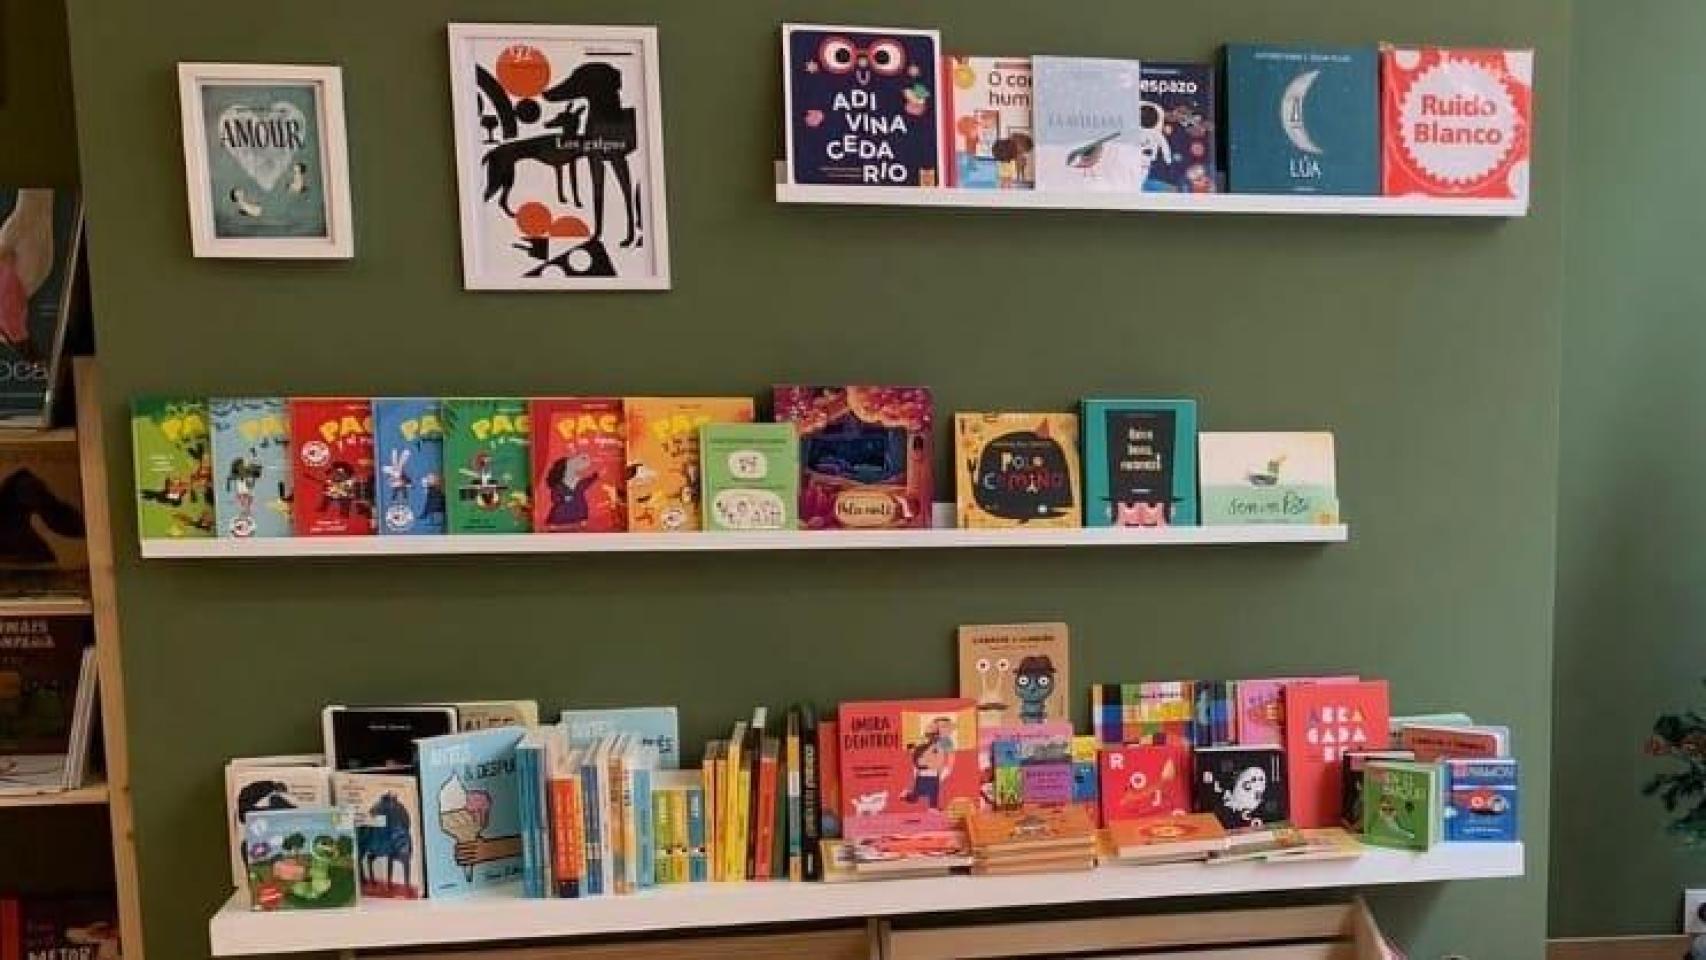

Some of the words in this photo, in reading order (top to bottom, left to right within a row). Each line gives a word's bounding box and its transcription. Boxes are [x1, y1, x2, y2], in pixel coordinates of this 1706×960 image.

[832, 88, 877, 112] ADI
[1419, 95, 1498, 118] Ruido
[220, 118, 304, 149] AMOUR
[844, 112, 908, 134] VINA
[1413, 123, 1504, 146] Blanco
[825, 135, 895, 160] CEDA
